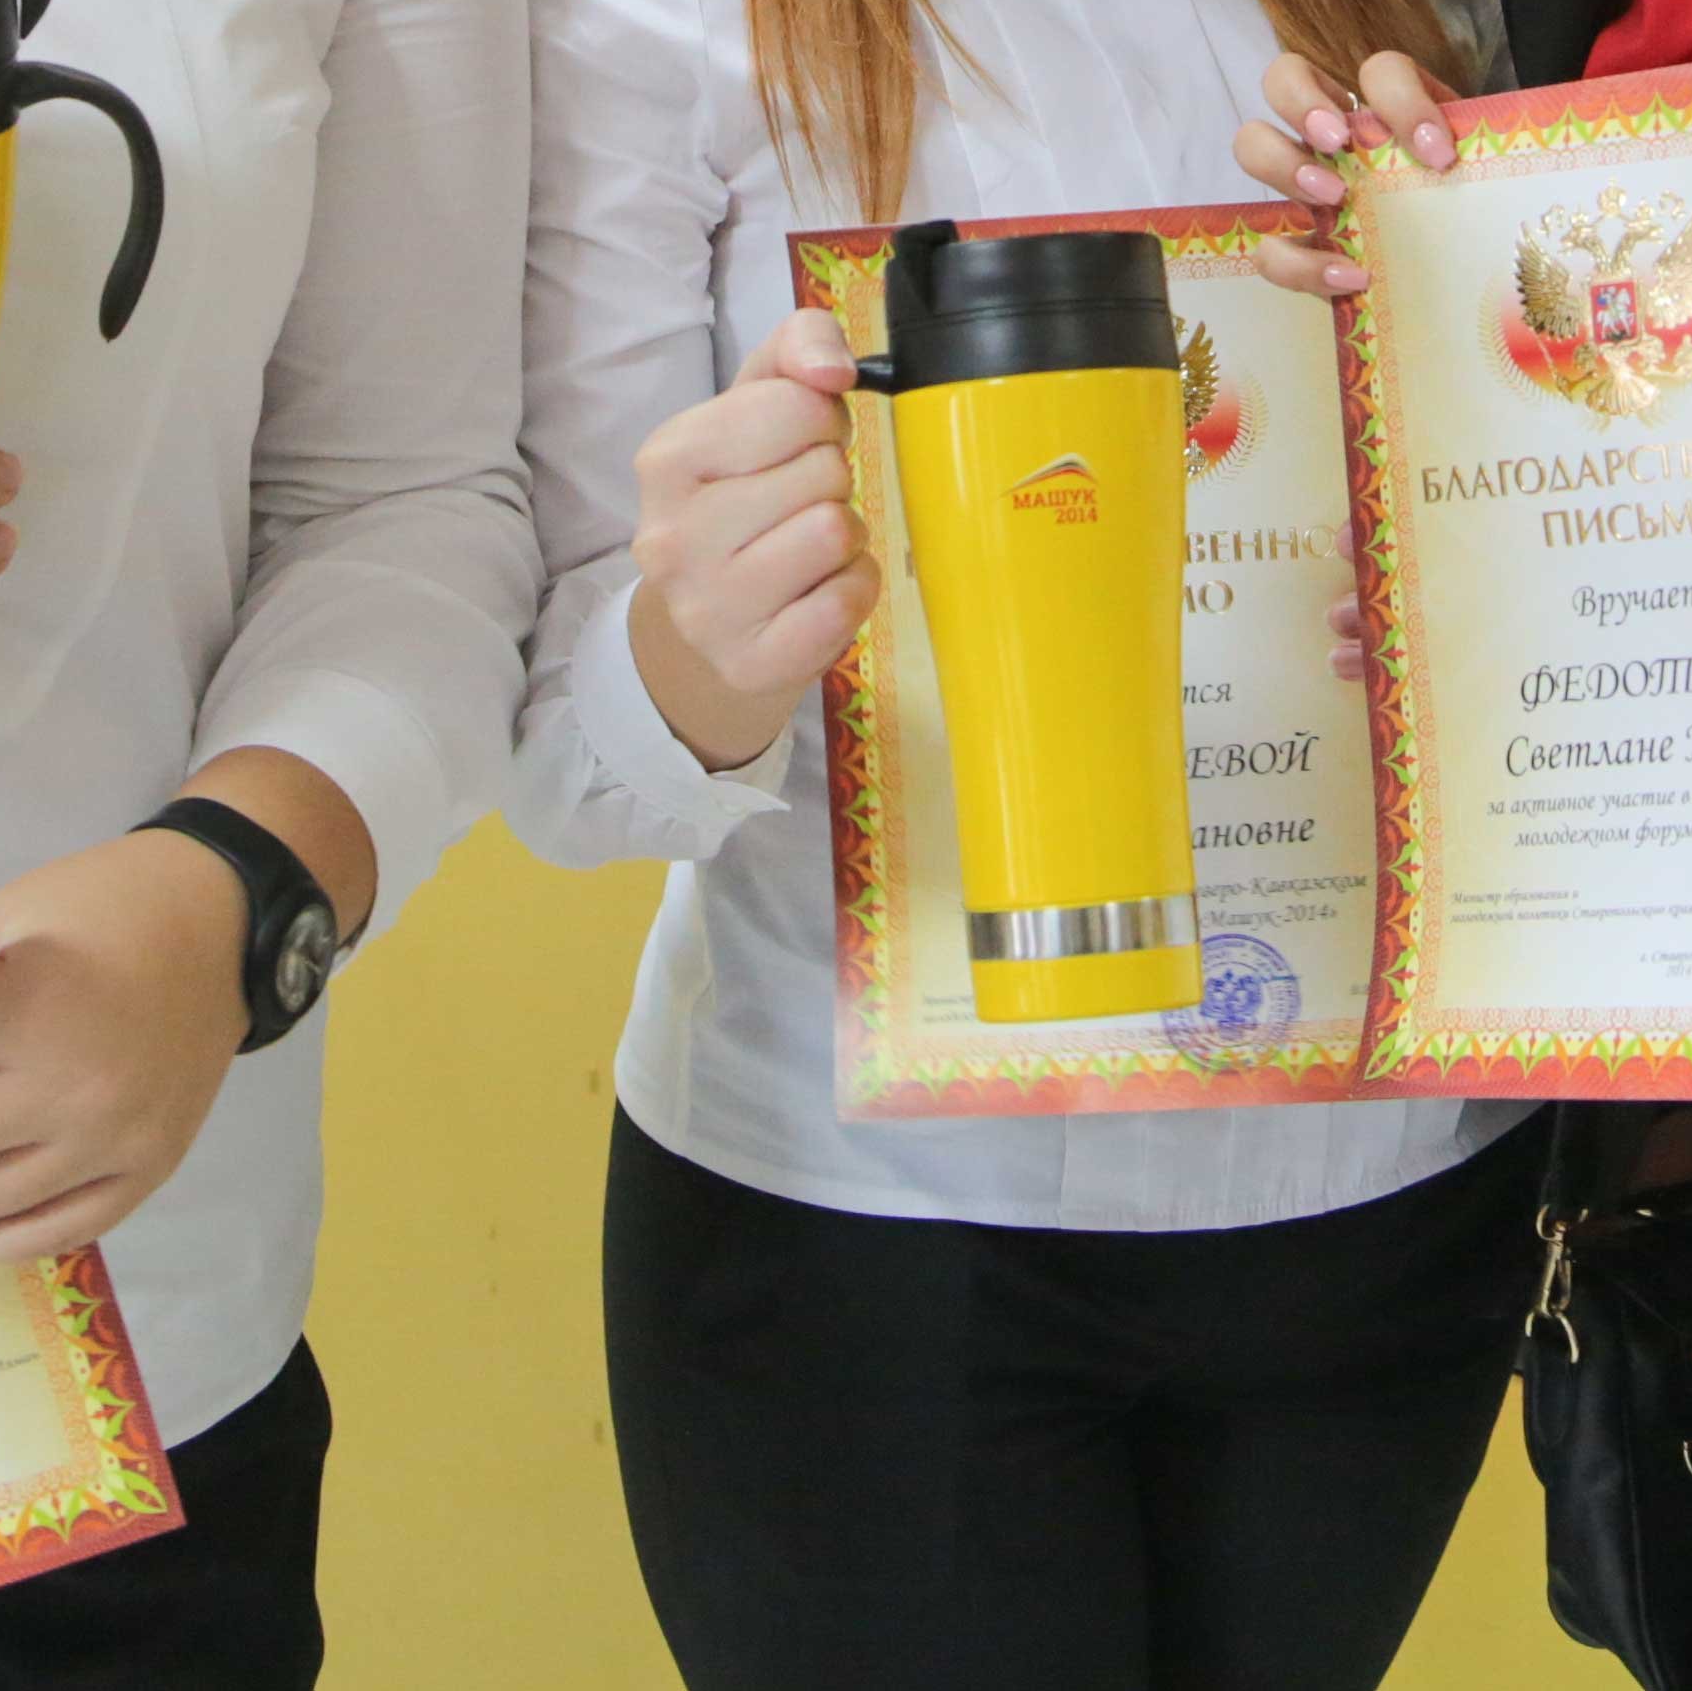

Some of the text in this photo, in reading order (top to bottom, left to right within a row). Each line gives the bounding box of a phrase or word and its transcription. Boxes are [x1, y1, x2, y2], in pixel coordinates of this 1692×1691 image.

[1012, 489, 1096, 511] МАШУК
[1055, 507, 1098, 524] 2014
[1185, 730, 1320, 780] ЕВОЙ
[1505, 734, 1674, 777] Светлане
[1486, 799, 1506, 817] за
[1510, 796, 1596, 822] активное
[1599, 790, 1676, 817] участие
[1680, 788, 1691, 804] в
[1191, 818, 1315, 850] ановне
[1514, 820, 1630, 848] молодежном
